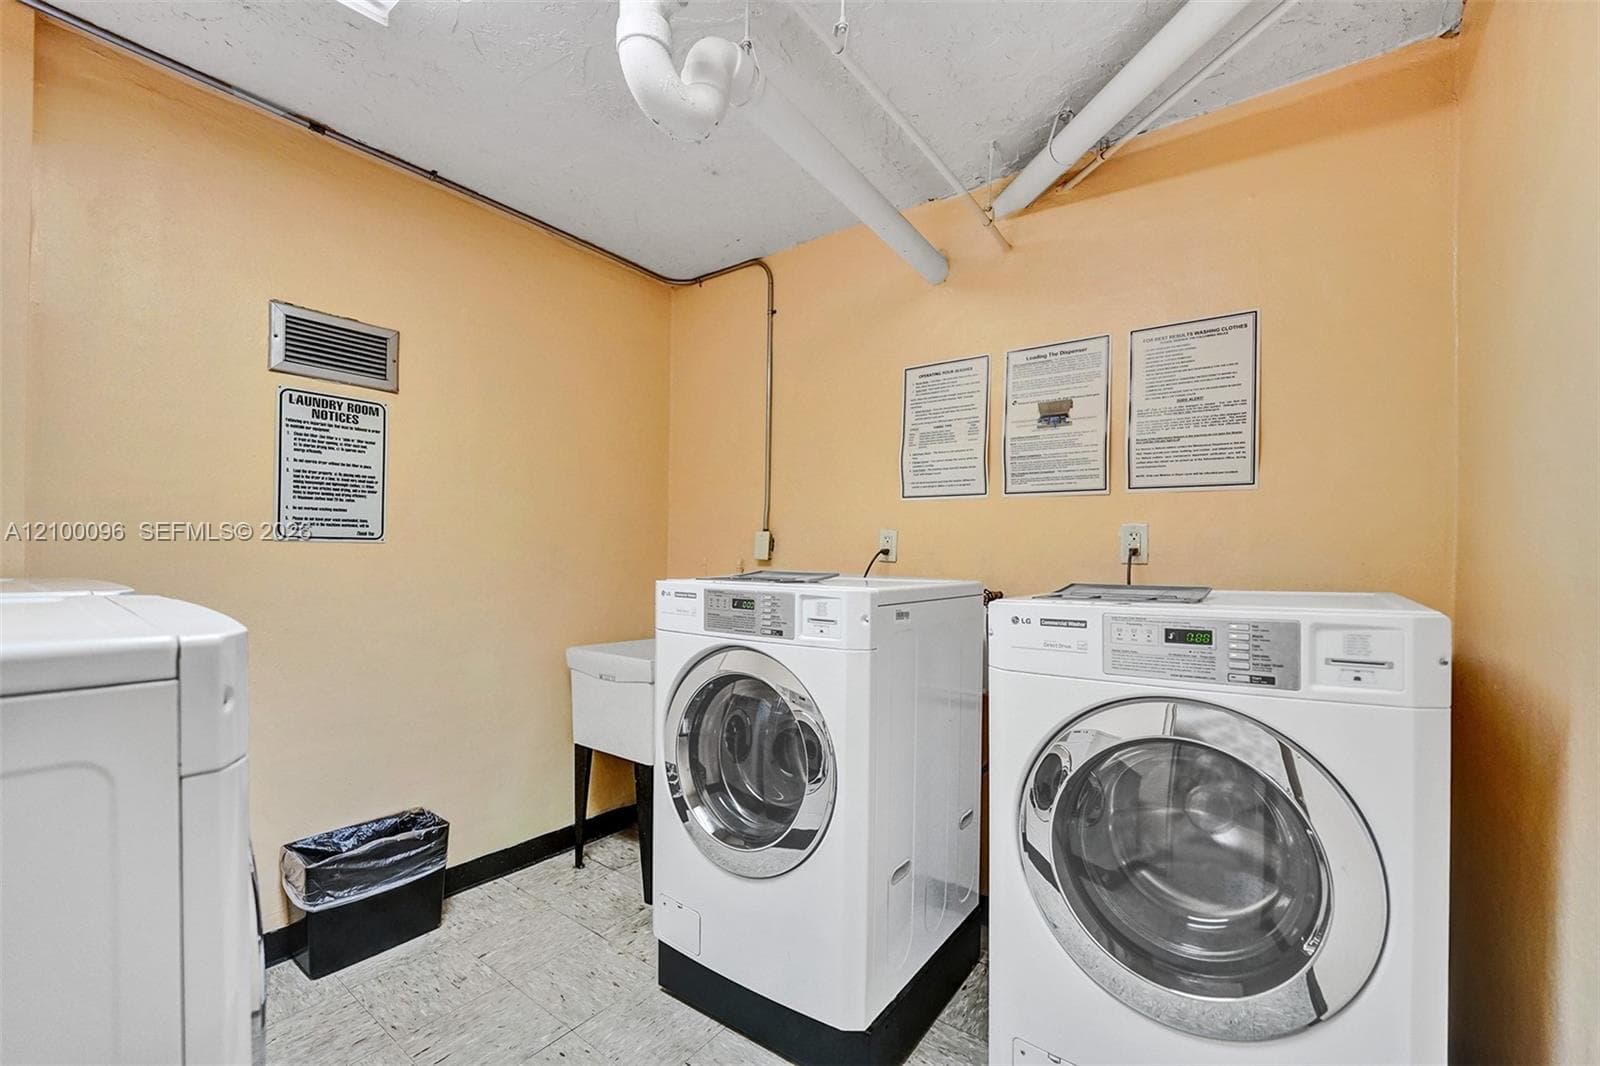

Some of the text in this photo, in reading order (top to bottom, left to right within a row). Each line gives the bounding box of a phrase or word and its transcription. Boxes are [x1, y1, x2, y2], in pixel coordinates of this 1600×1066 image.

[1194, 327, 1220, 336] WASHING
[1221, 322, 1249, 333] CLOTHES
[1025, 347, 1088, 362] Loading The Dispenser
[918, 371, 942, 379] OPERATING
[288, 393, 379, 416] LAUNDRY ROOM
[311, 408, 359, 425] NOTICES
